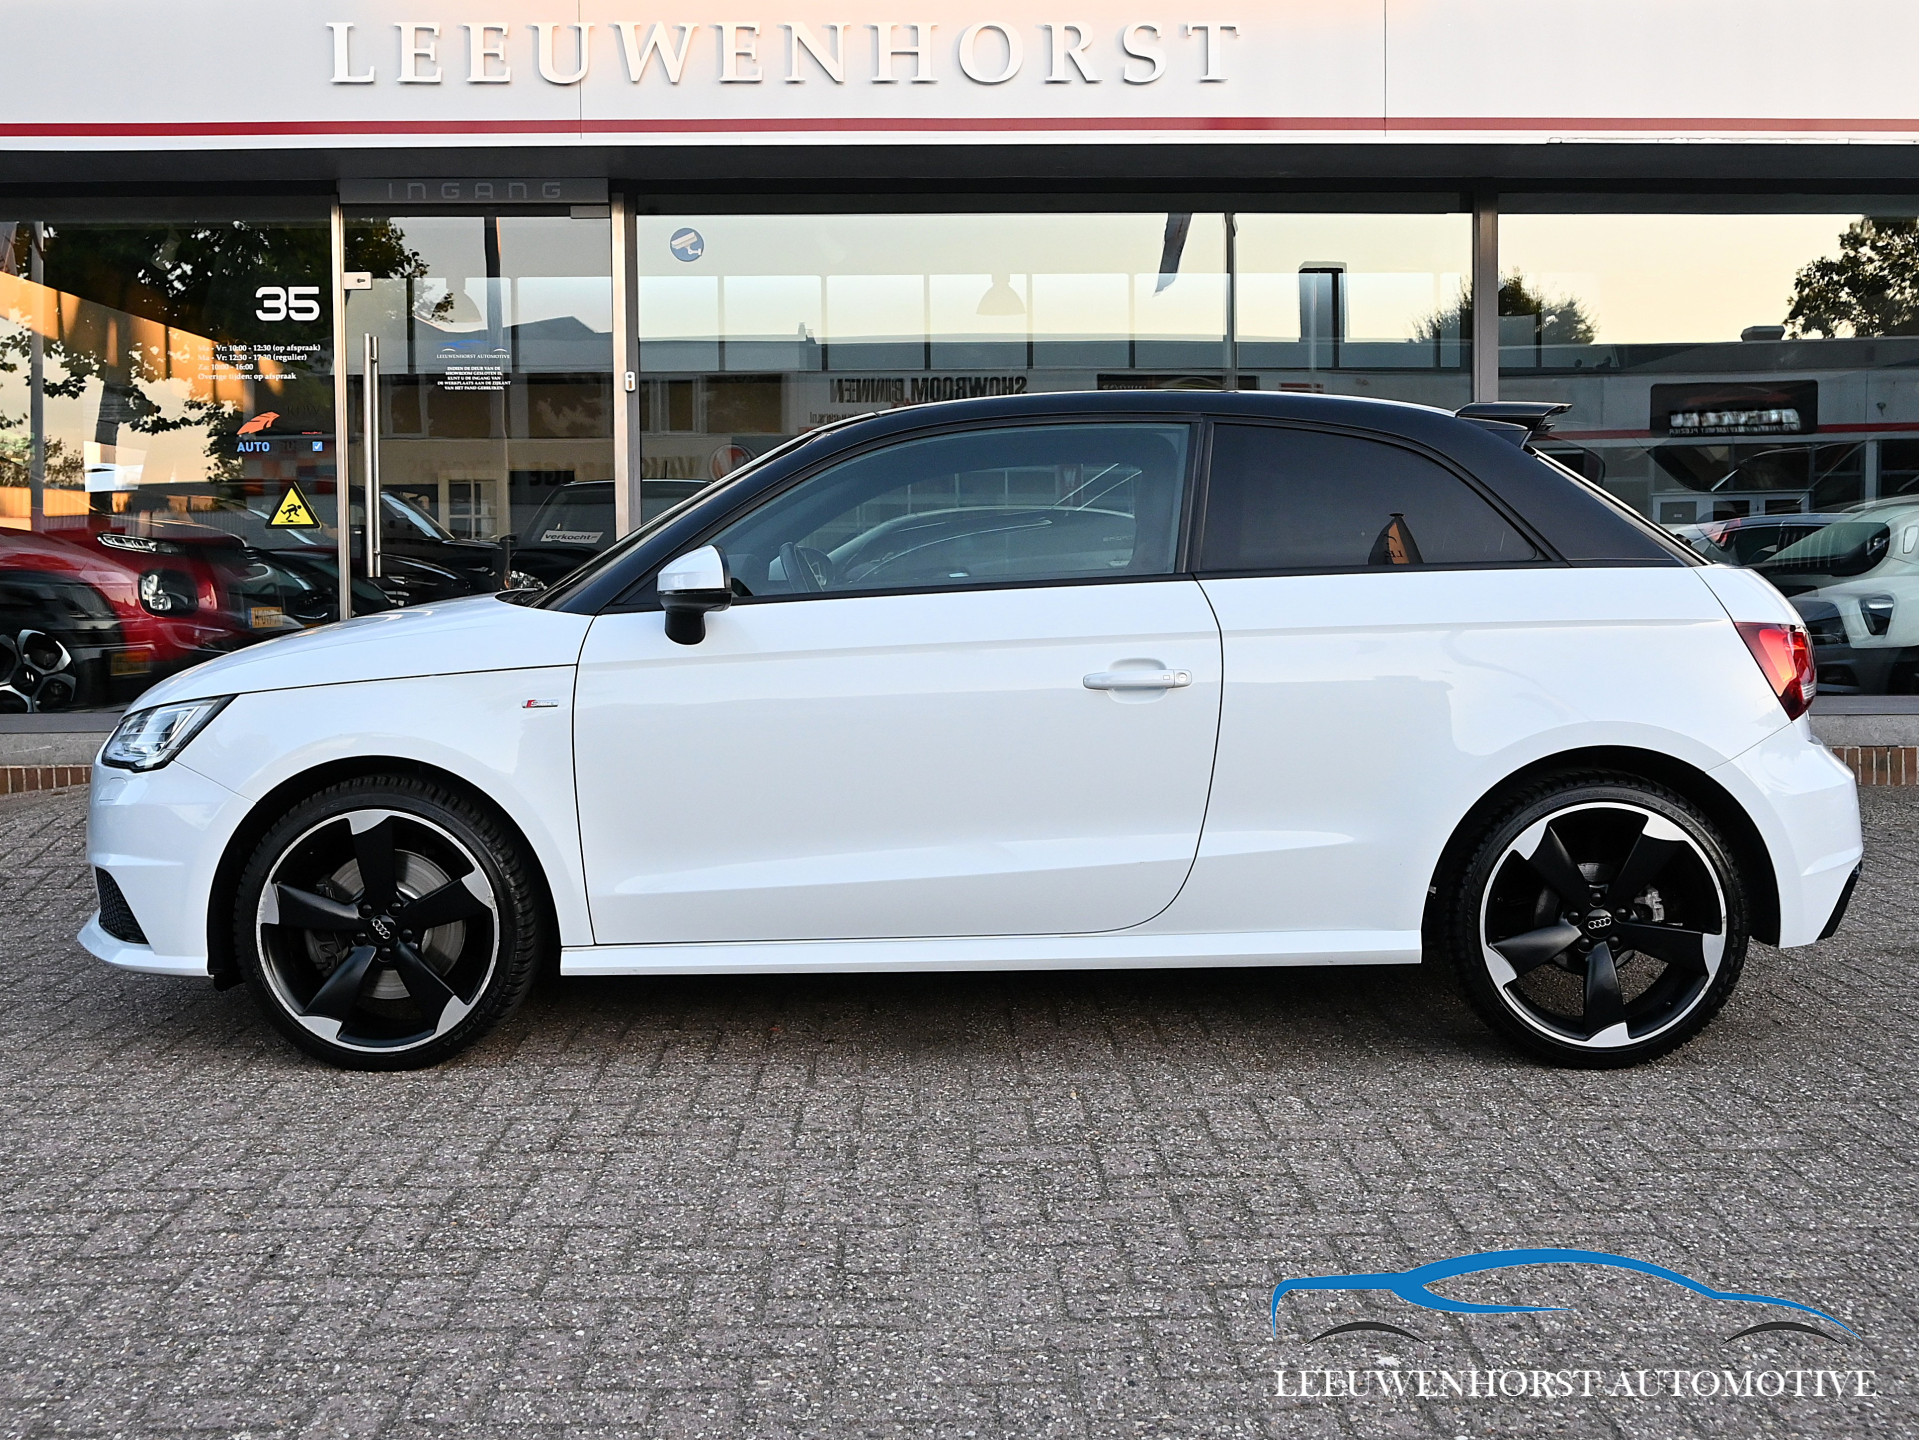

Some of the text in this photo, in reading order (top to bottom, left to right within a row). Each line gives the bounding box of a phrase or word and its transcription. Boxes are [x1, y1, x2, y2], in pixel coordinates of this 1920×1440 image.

[326, 20, 1241, 85] LEEUWENHORST
[388, 182, 561, 199] INGANG
[255, 286, 320, 321] 35
[273, 344, 285, 353] (op
[286, 344, 321, 353] afspraak)
[273, 354, 307, 363] (regulier)
[198, 373, 226, 382] Overige
[253, 374, 264, 382] op
[265, 373, 297, 382] afspraak
[236, 442, 270, 452] AUTO
[545, 533, 591, 541] verkocht
